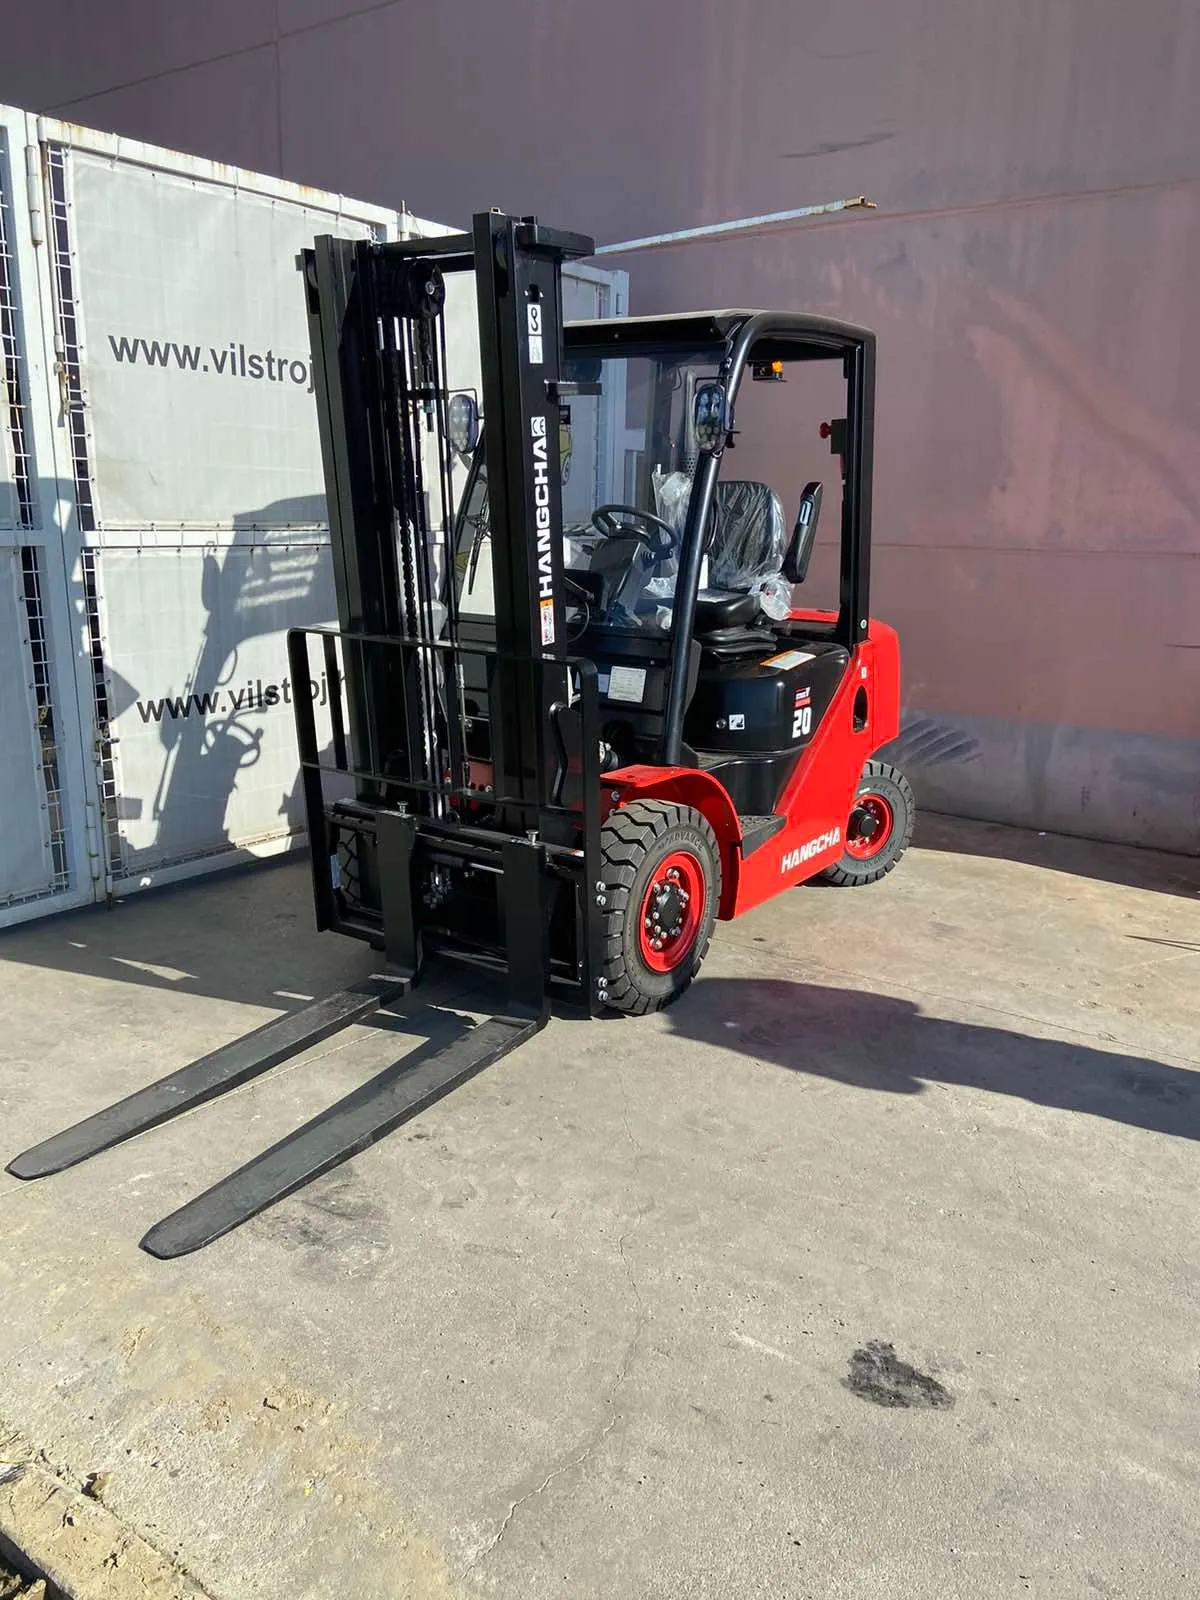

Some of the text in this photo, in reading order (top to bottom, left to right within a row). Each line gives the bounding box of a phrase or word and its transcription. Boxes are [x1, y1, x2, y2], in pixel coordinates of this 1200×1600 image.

[533, 436, 553, 598] HANGCHA
[792, 707, 811, 738] 20
[781, 827, 840, 873] HANGCHA
